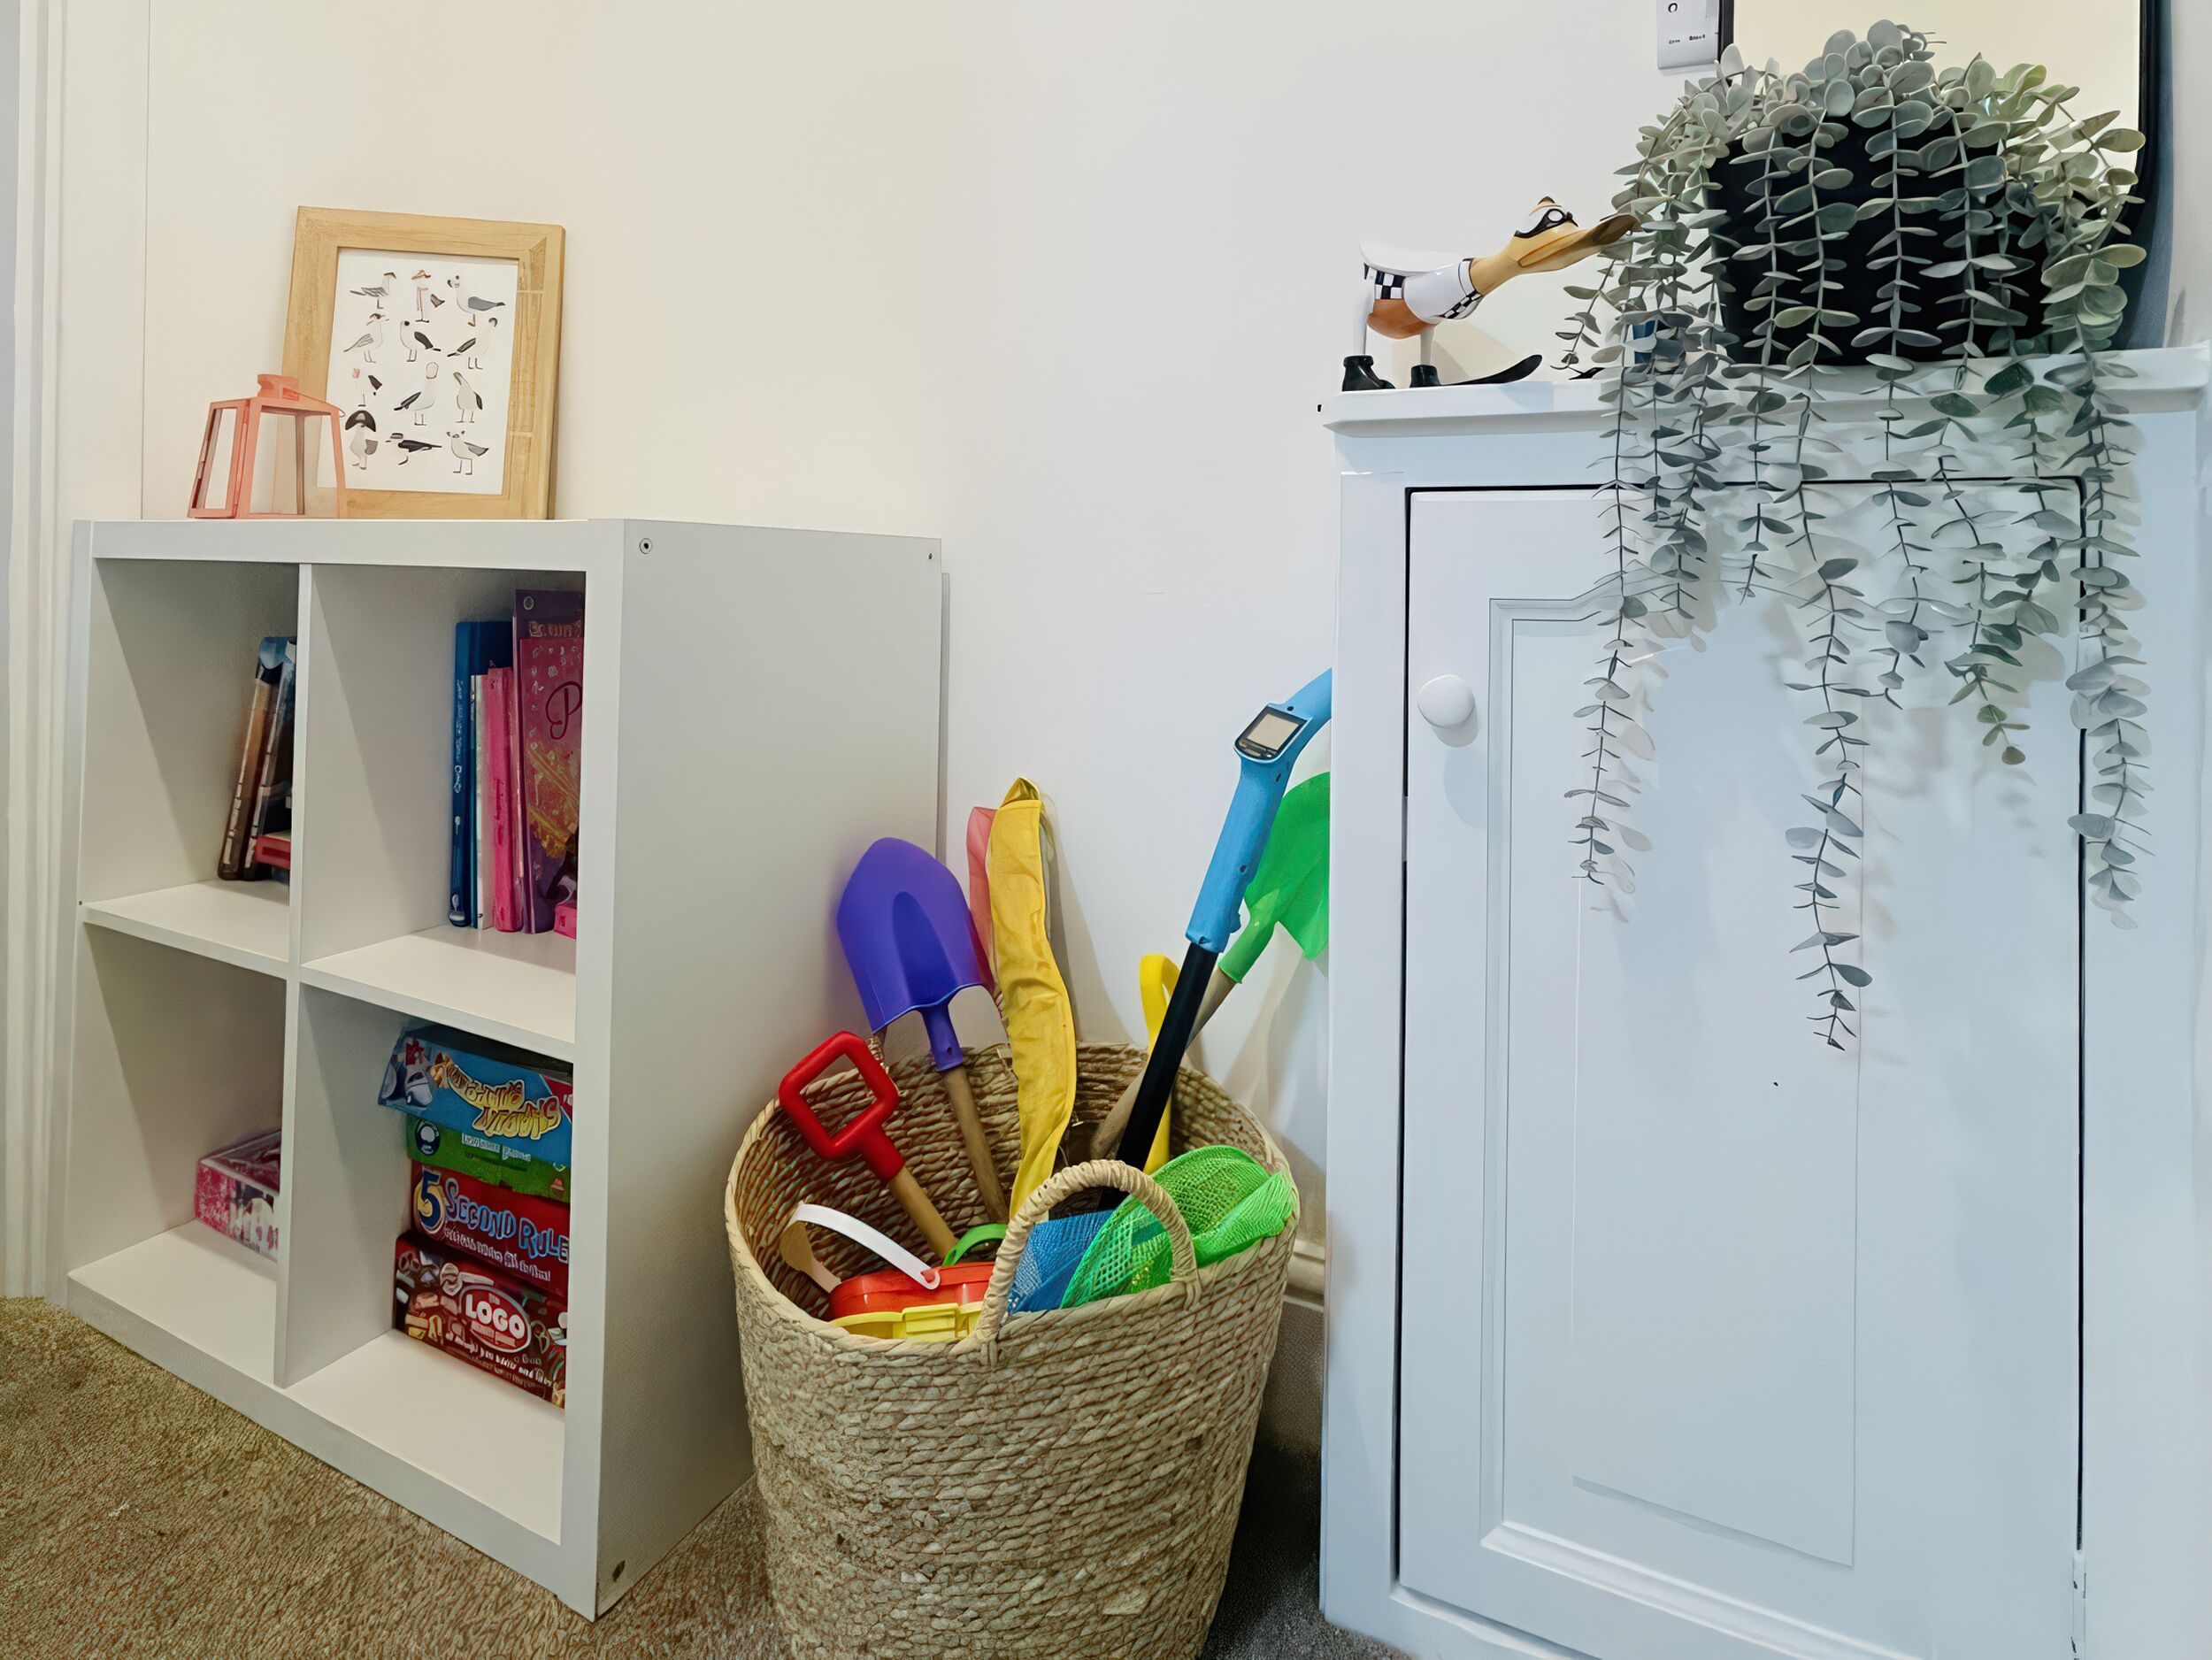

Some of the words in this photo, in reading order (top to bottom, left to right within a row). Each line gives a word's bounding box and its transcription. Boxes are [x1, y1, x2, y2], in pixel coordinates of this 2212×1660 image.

[417, 1167, 442, 1230] 5
[518, 1217, 570, 1264] RULE
[465, 1294, 526, 1340] LOGO
